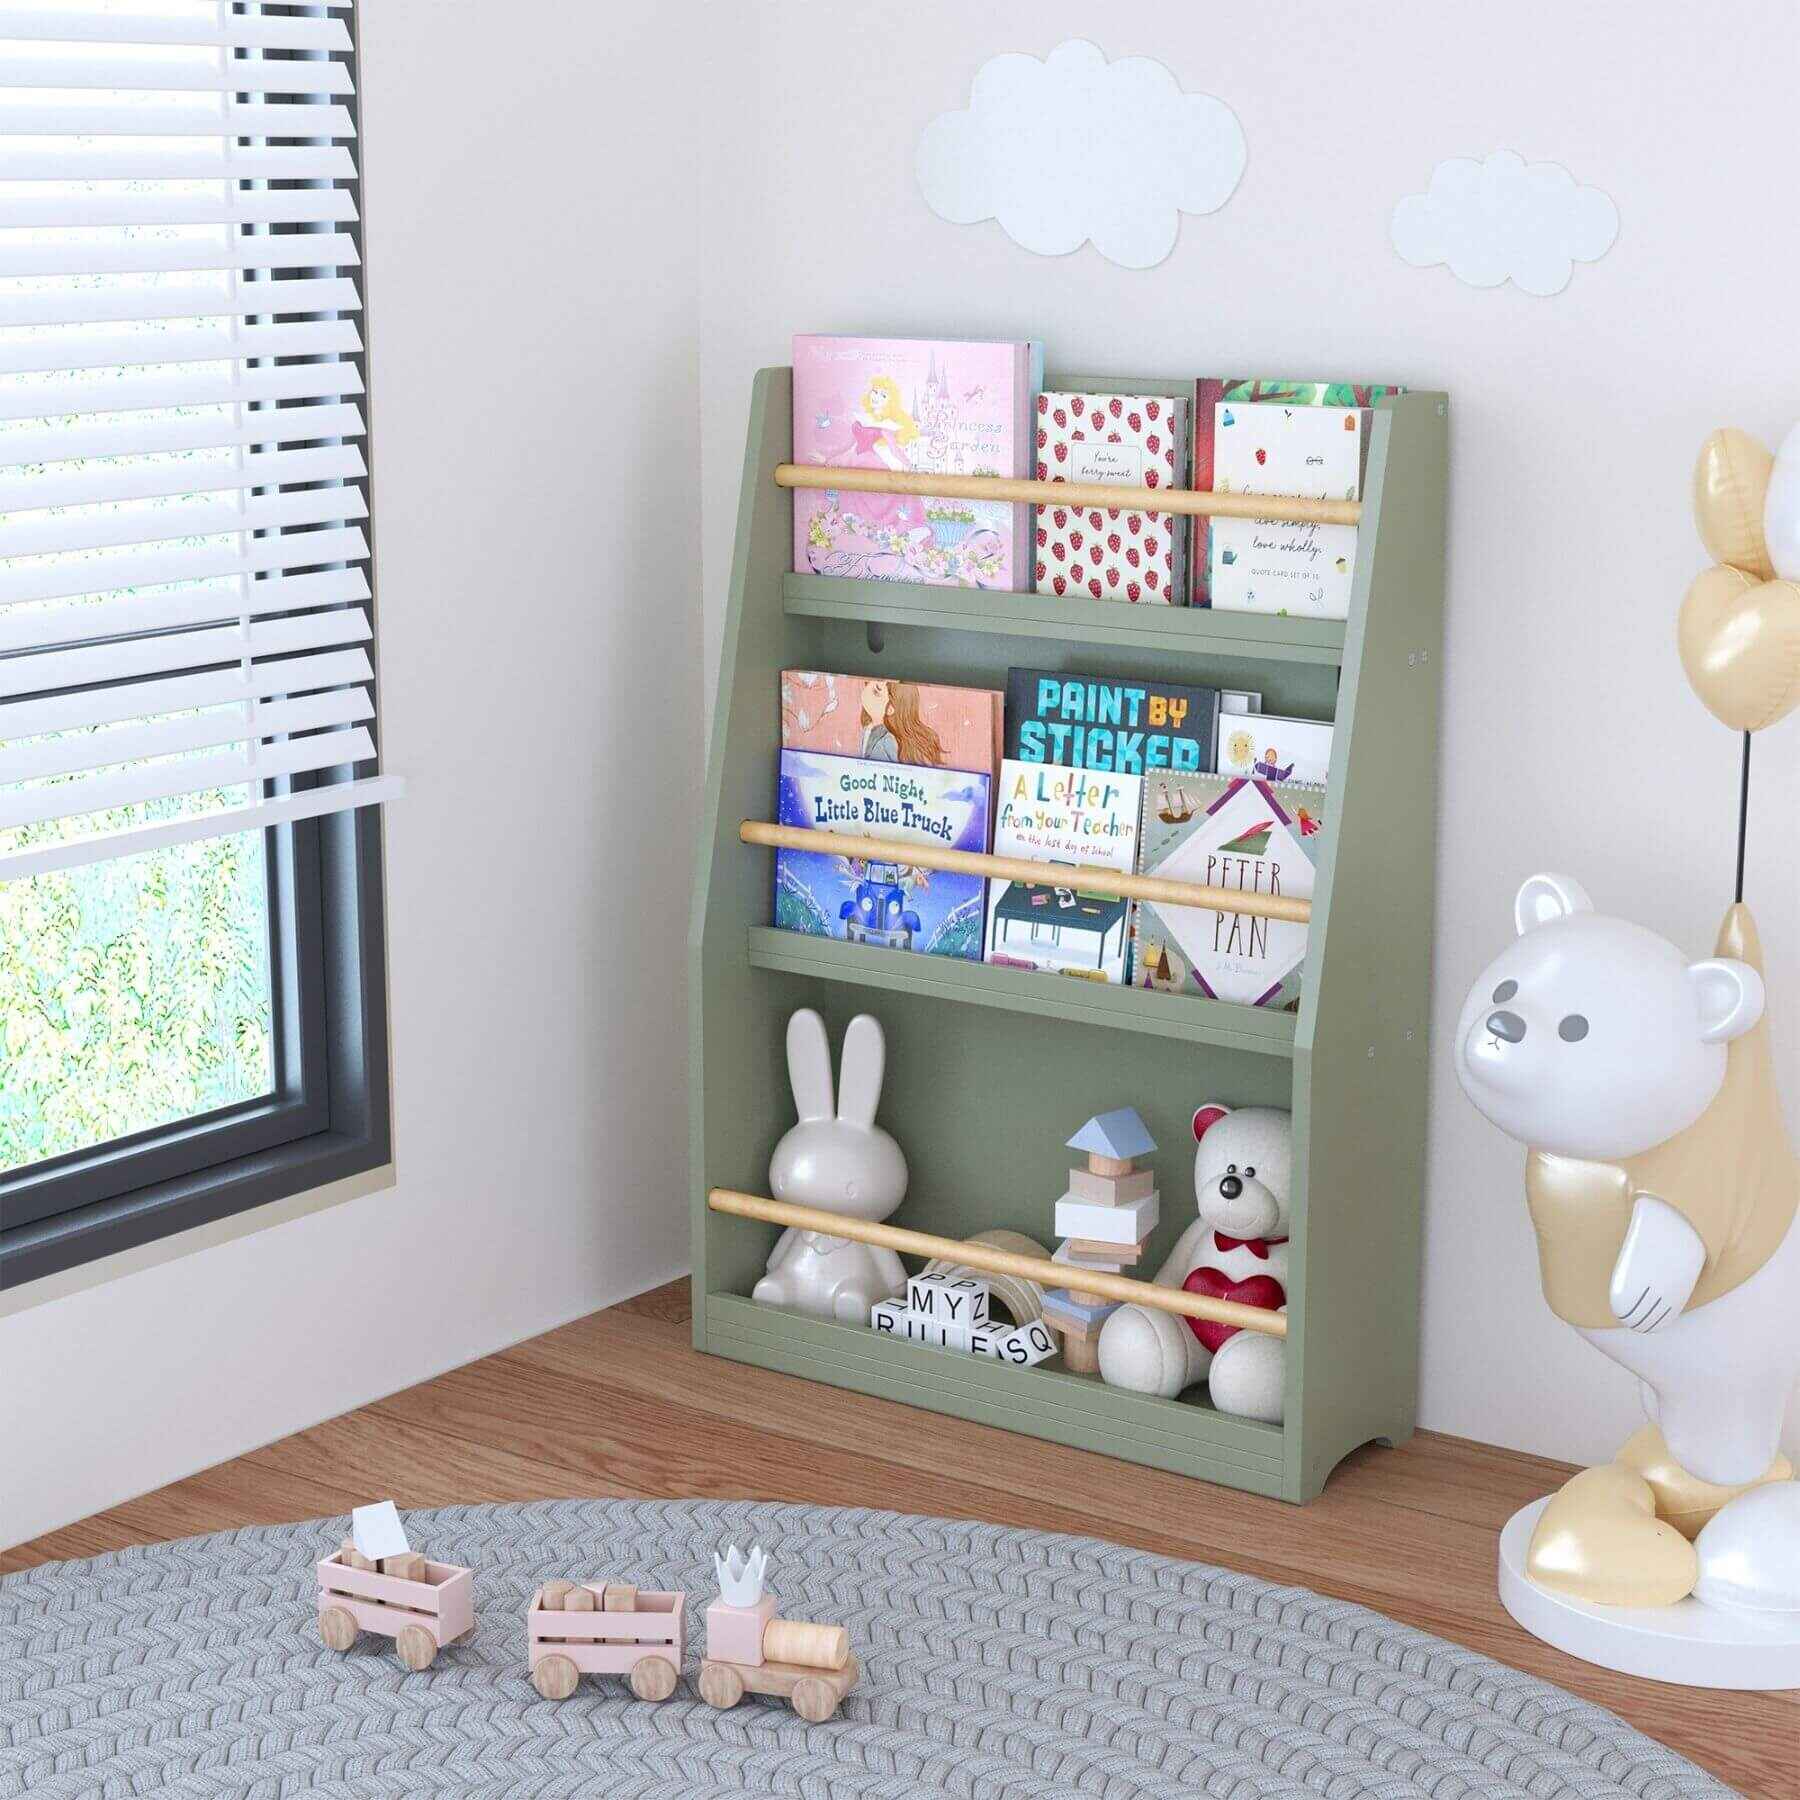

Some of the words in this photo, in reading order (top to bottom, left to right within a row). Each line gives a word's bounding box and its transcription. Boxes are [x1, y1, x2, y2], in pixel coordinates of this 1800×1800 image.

[1036, 678, 1146, 727] PAINT
[1148, 695, 1188, 729] BY
[840, 773, 877, 792] Good
[882, 774, 928, 805] Night,
[1014, 774, 1027, 800] A
[1036, 771, 1120, 809] Letter
[814, 796, 859, 823] Little
[863, 797, 899, 824] Blue
[901, 802, 953, 841] Truck
[1001, 803, 1033, 829] from
[1070, 810, 1134, 837] Teacher
[1213, 911, 1269, 960] PAN
